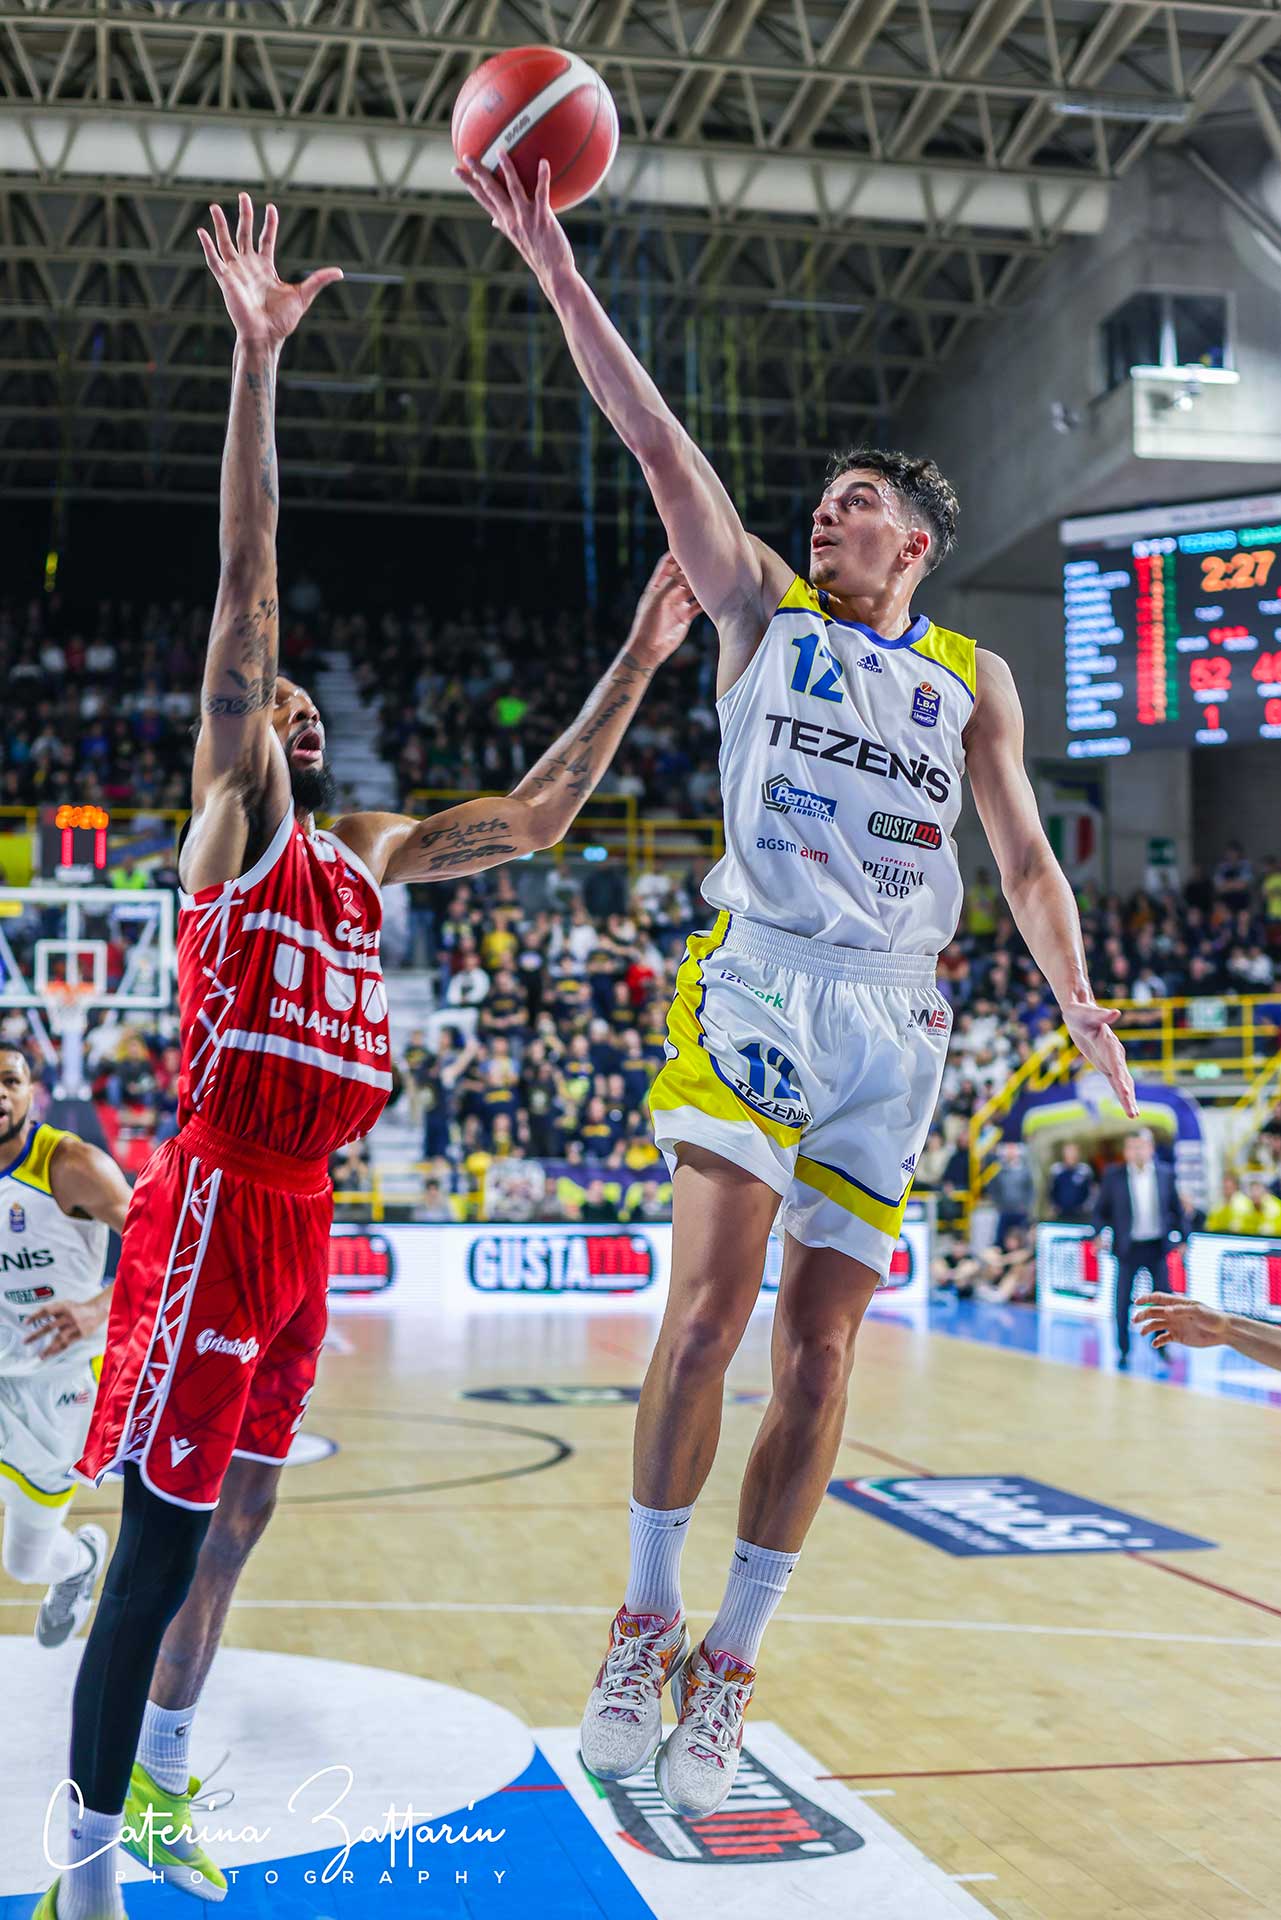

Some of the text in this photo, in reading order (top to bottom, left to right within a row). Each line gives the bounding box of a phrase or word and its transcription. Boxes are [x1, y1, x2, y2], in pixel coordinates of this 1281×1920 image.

[1201, 550, 1277, 592] 2:27
[791, 632, 845, 704] 12
[856, 660, 883, 674] adidas
[916, 697, 937, 711] LBA
[775, 786, 831, 815] Pentax
[862, 860, 924, 886] PELLINI
[880, 856, 915, 868] ESPRESSO
[875, 880, 910, 899] TOP
[737, 1042, 801, 1103] 12
[0, 1246, 55, 1274] NiS
